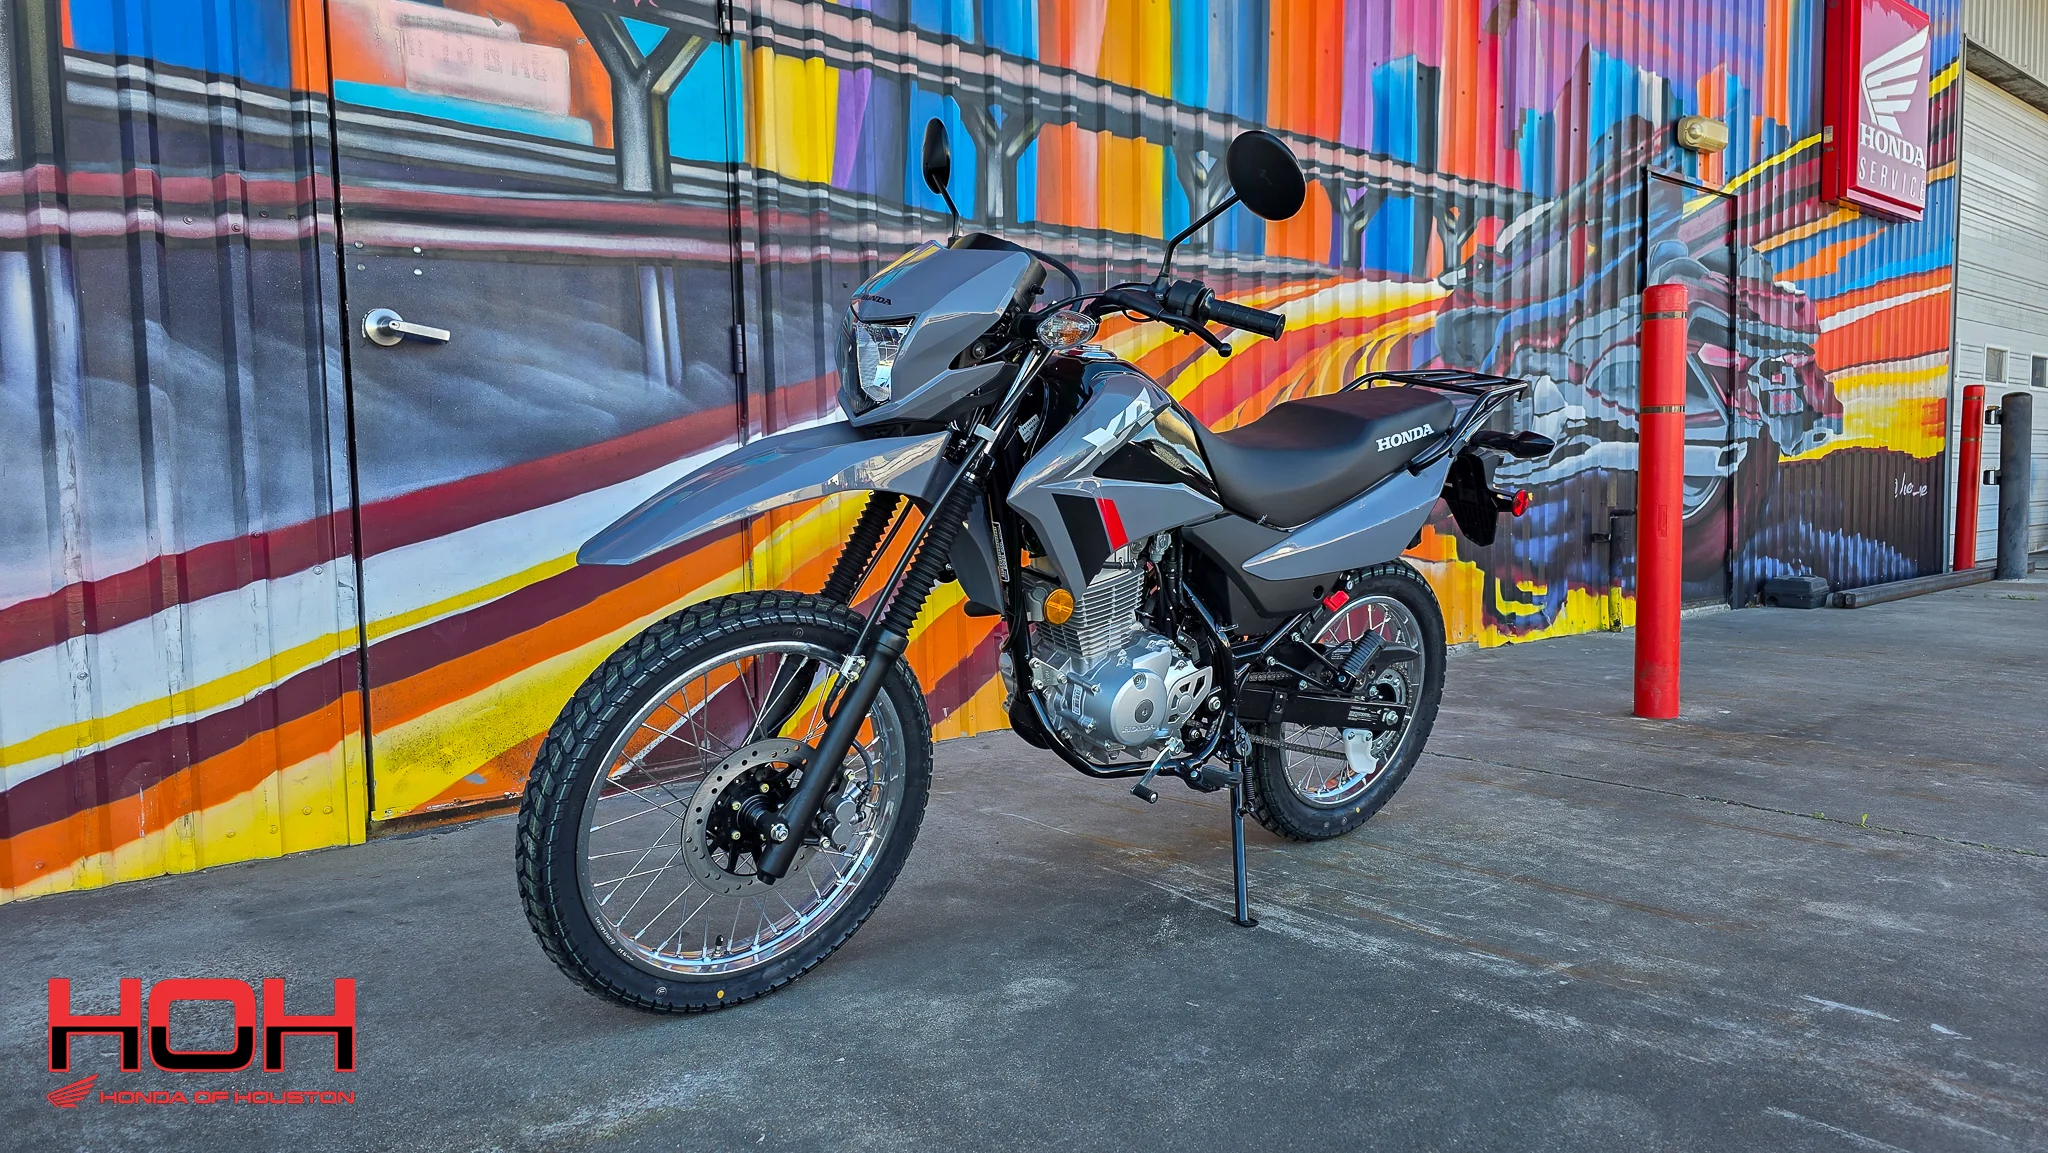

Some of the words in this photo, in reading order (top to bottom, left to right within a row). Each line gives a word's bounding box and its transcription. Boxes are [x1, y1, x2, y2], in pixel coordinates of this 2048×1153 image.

[1860, 122, 1926, 171] HONDA
[1859, 157, 1925, 201] SERVICE
[1376, 423, 1434, 452] HONDA
